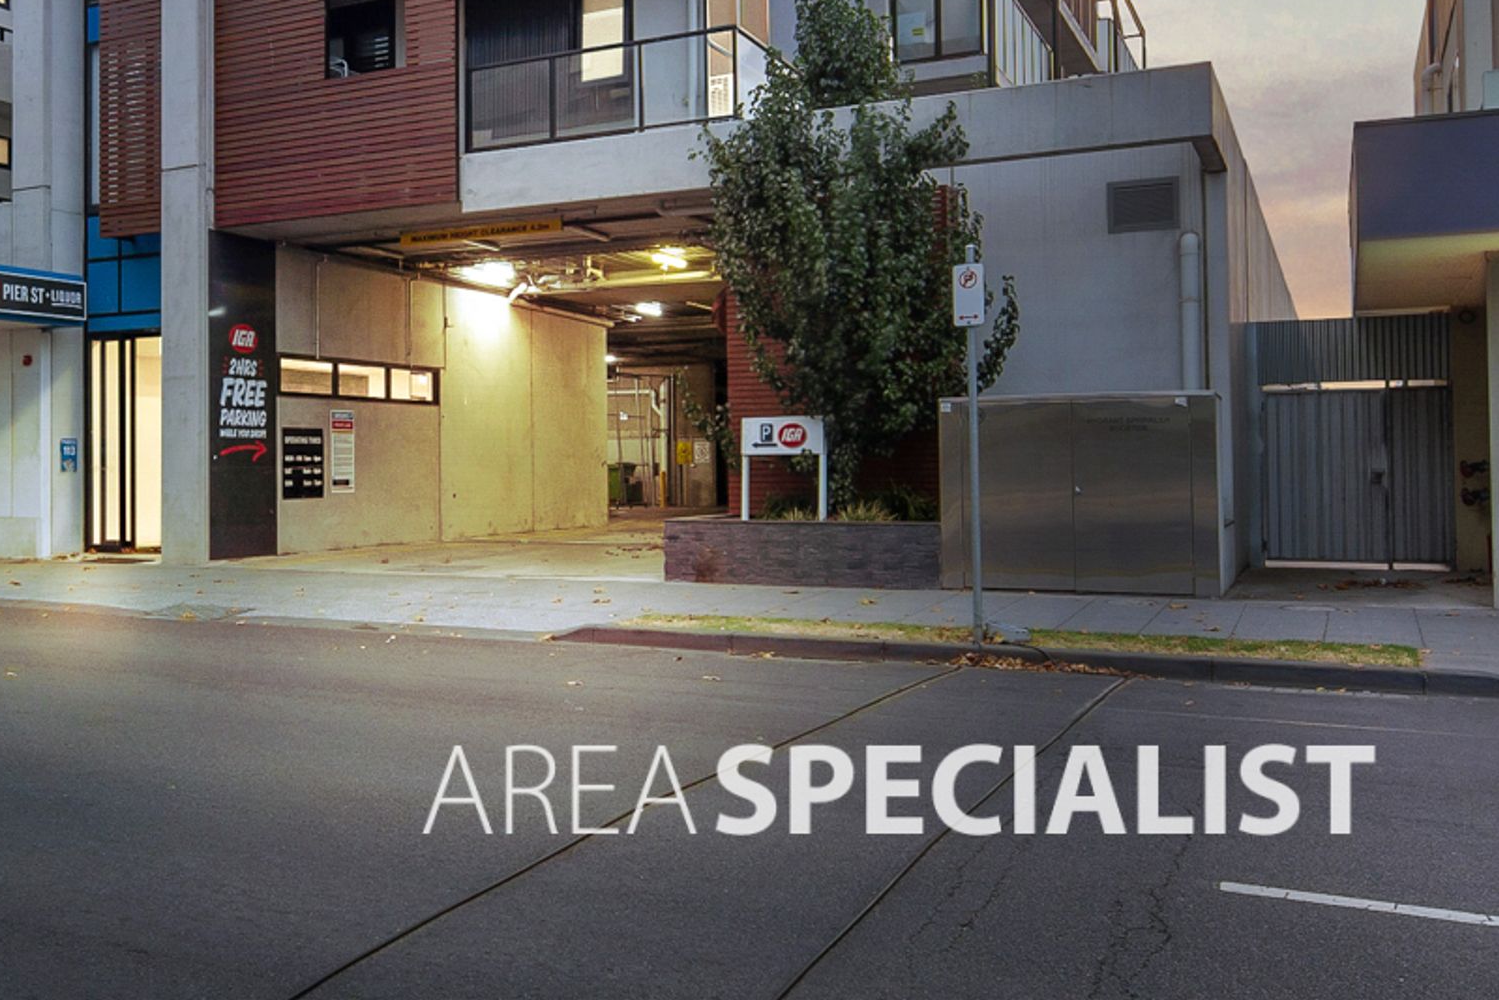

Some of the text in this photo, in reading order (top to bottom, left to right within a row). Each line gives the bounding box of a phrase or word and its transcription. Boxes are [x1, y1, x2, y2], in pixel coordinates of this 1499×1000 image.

[3, 283, 29, 303] PIER
[30, 287, 45, 303] ST
[51, 289, 81, 304] LIQUOR
[231, 328, 256, 347] IGA
[219, 377, 268, 408] FREE
[219, 408, 268, 428] PARKING
[762, 425, 803, 442] P IGA
